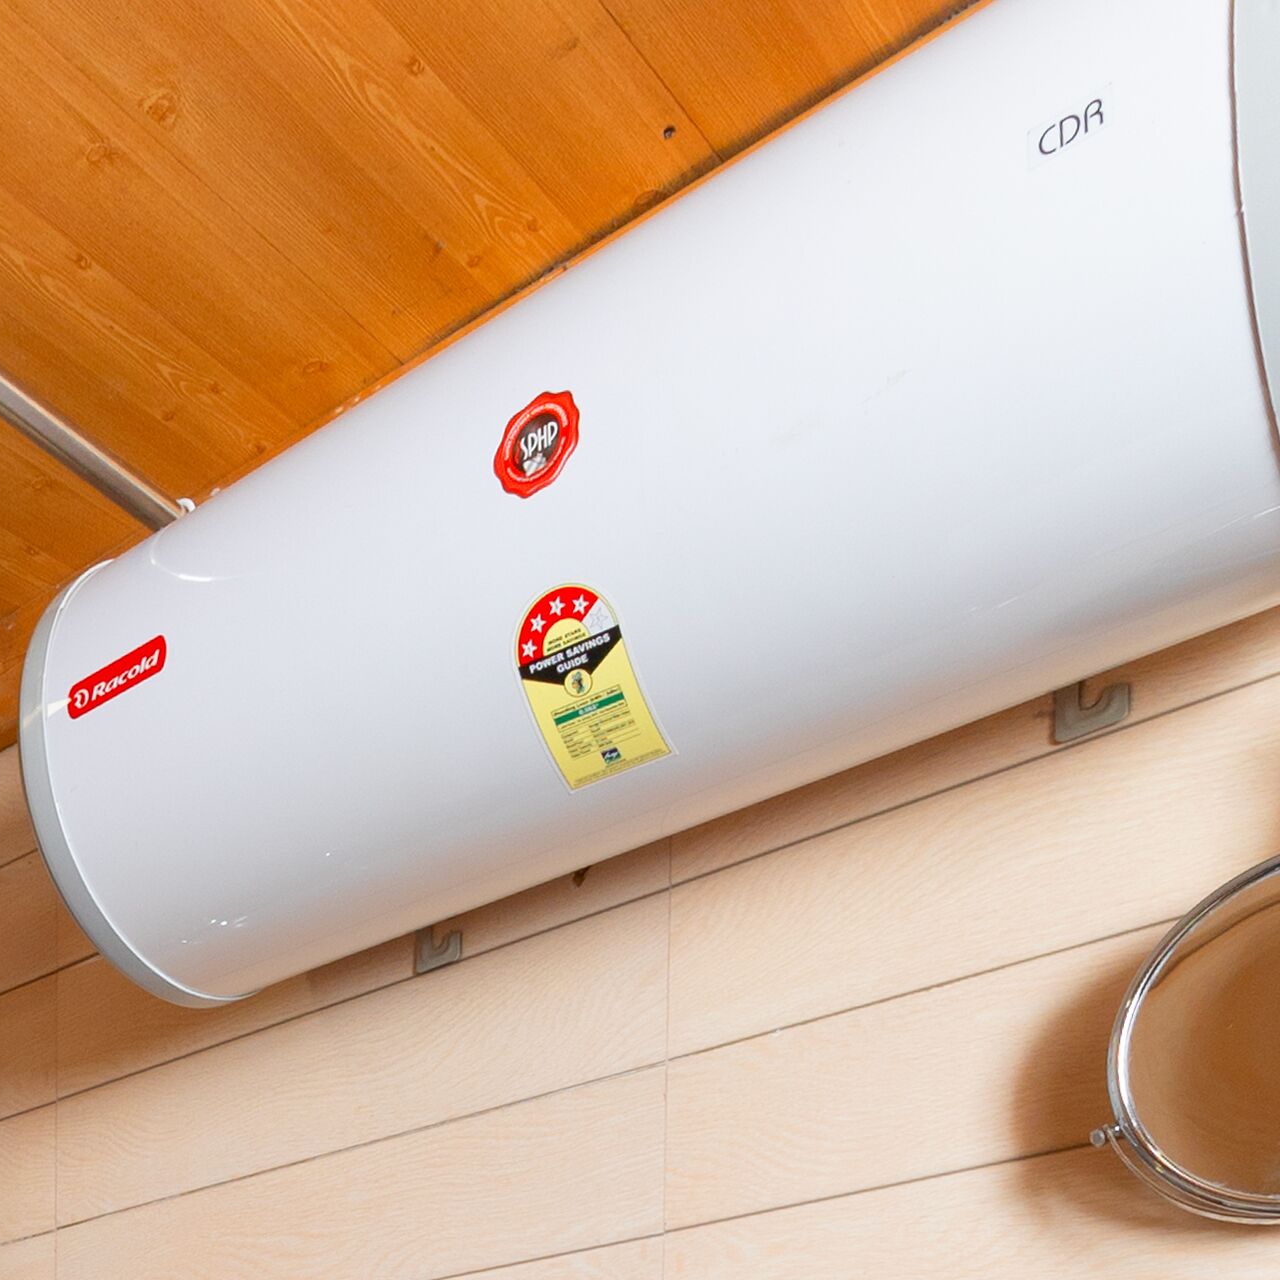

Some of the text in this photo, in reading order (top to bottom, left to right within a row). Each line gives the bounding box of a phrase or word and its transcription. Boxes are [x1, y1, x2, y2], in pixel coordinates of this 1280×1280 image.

[1038, 98, 1105, 156] CDR
[519, 421, 559, 461] SPHP
[528, 633, 610, 674] POWER SAVINGS
[556, 653, 589, 673] GUIDE
[91, 649, 161, 702] Racold
